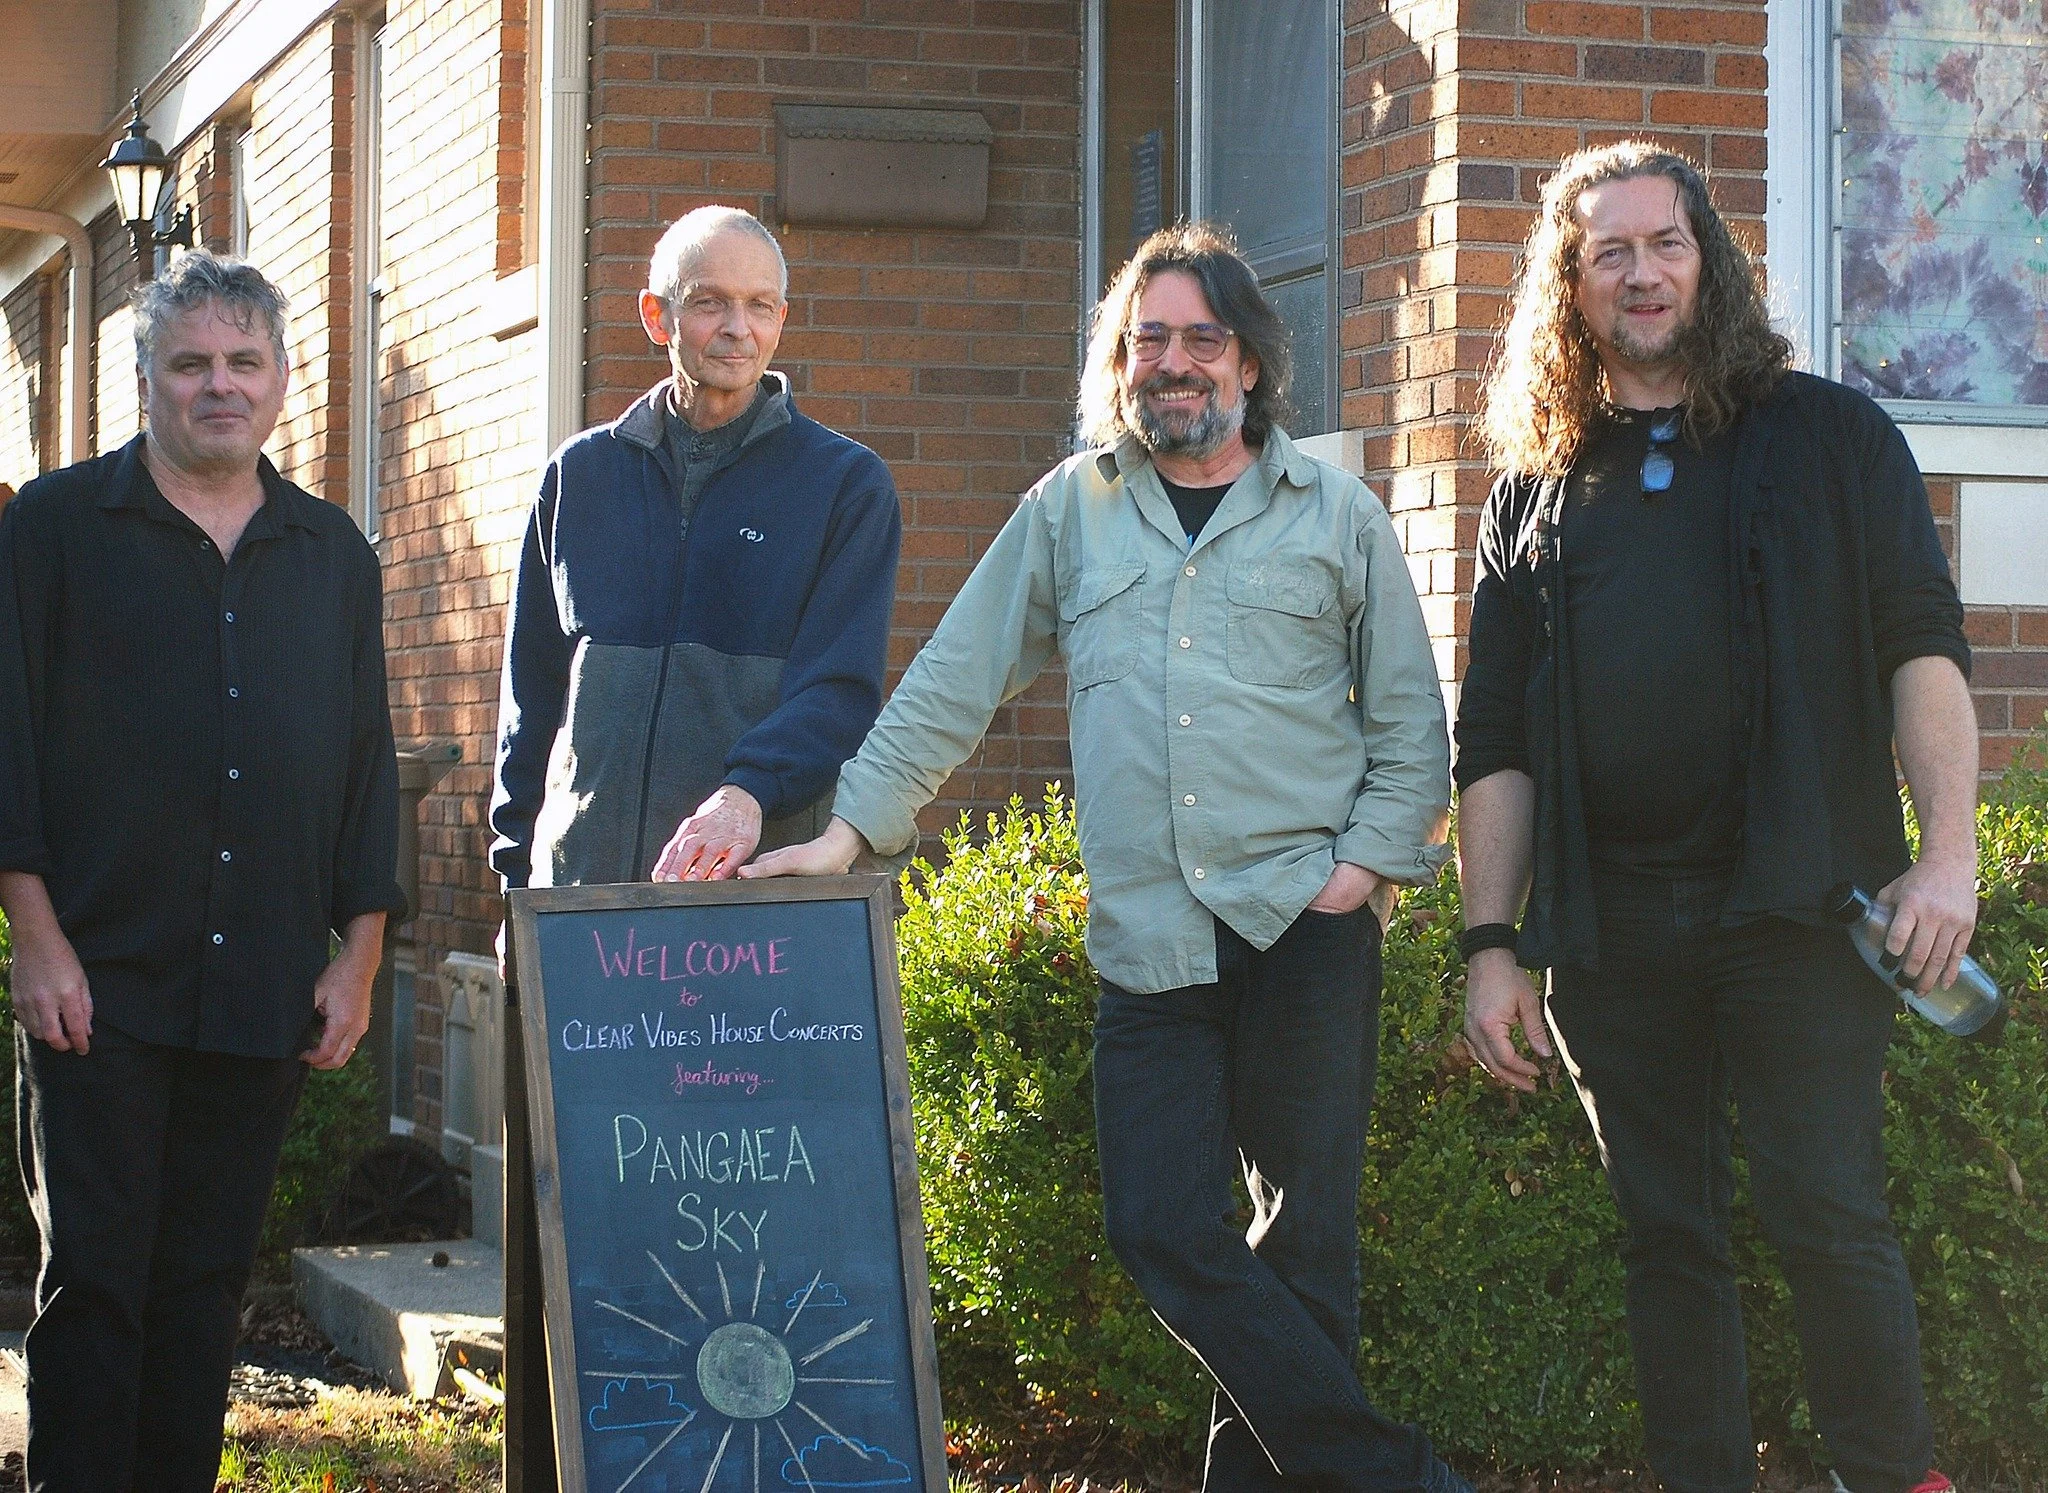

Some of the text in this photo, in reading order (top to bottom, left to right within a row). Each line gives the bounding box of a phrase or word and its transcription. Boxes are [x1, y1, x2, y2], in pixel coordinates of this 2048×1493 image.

[593, 927, 791, 981] WELCOME
[677, 987, 702, 1007] to
[562, 1007, 863, 1051] CLEAR VIBES HOUSE CONCERTS
[614, 1114, 816, 1185] PANGAEA
[676, 1192, 767, 1252] SKY
